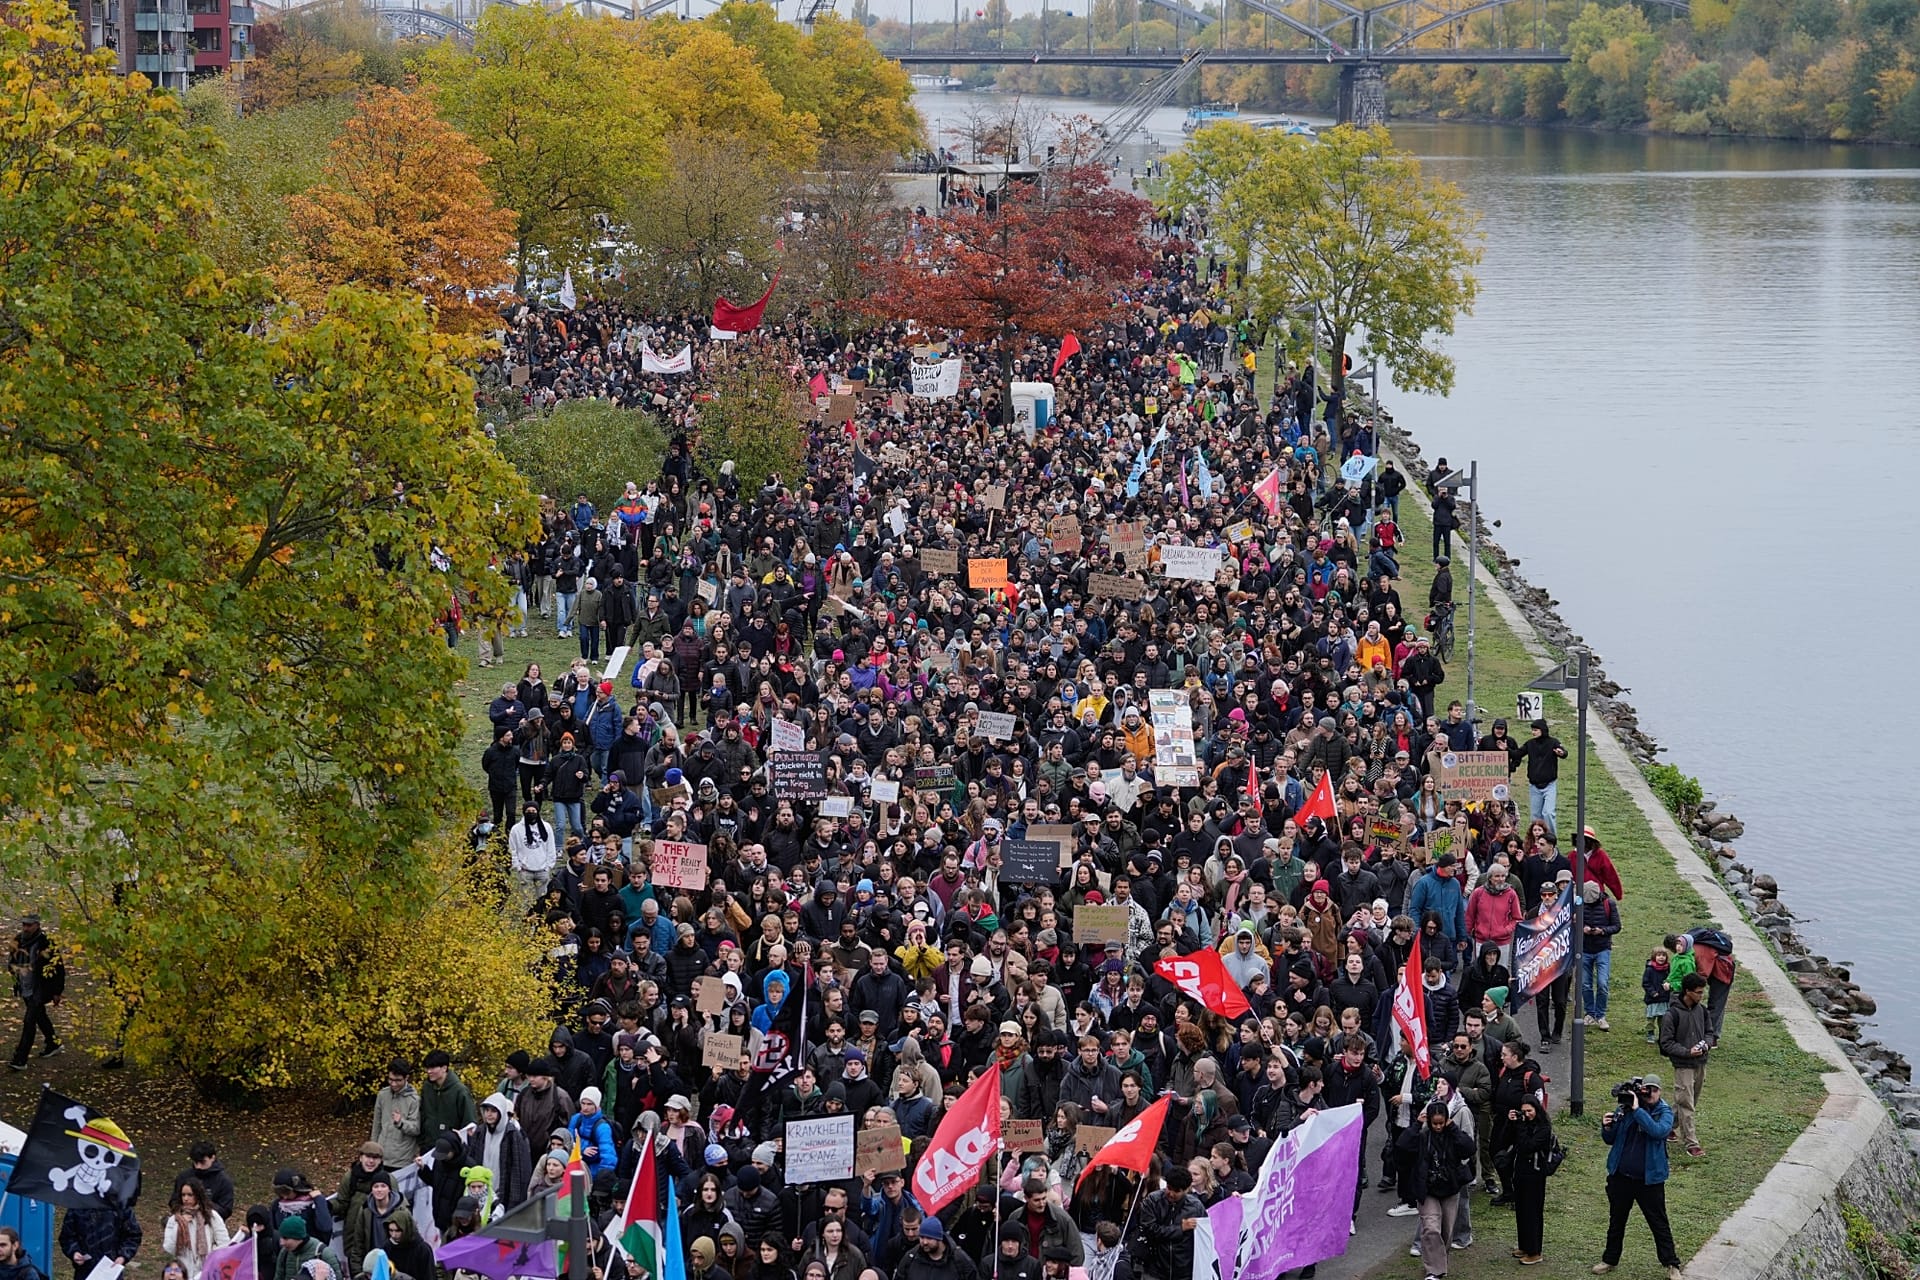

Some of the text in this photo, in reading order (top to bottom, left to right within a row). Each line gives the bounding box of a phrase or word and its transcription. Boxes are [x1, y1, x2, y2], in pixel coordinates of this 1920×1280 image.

[662, 843, 690, 857] THEY
[681, 857, 702, 868] REALLY
[655, 864, 677, 875] CARE
[668, 875, 683, 886] US
[1013, 1120, 1041, 1128] JUGEND
[787, 1121, 849, 1139] KRANKHEIT
